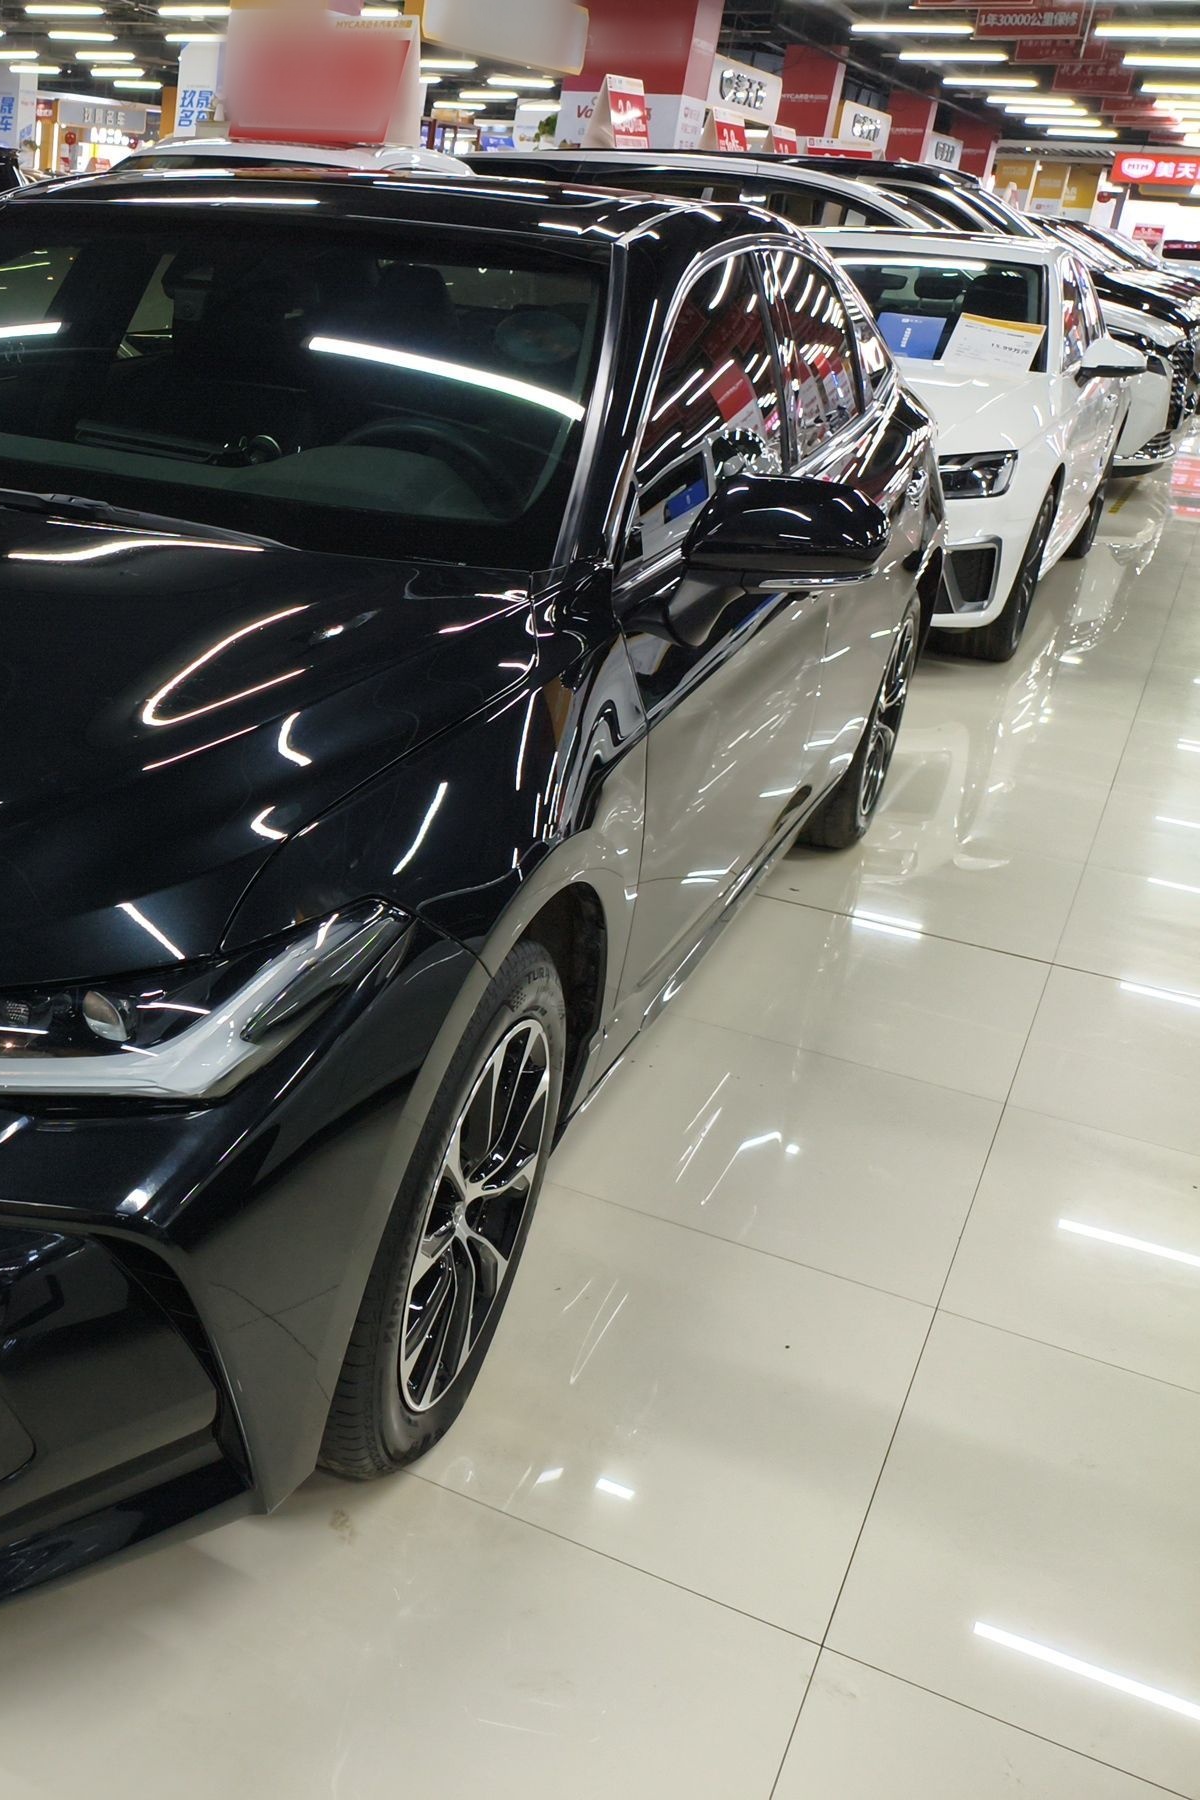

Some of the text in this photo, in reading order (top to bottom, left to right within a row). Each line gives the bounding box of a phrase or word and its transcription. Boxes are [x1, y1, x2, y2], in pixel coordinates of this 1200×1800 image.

[980, 12, 1078, 26] 1年30000公里保修
[1155, 161, 1200, 179] 美天
